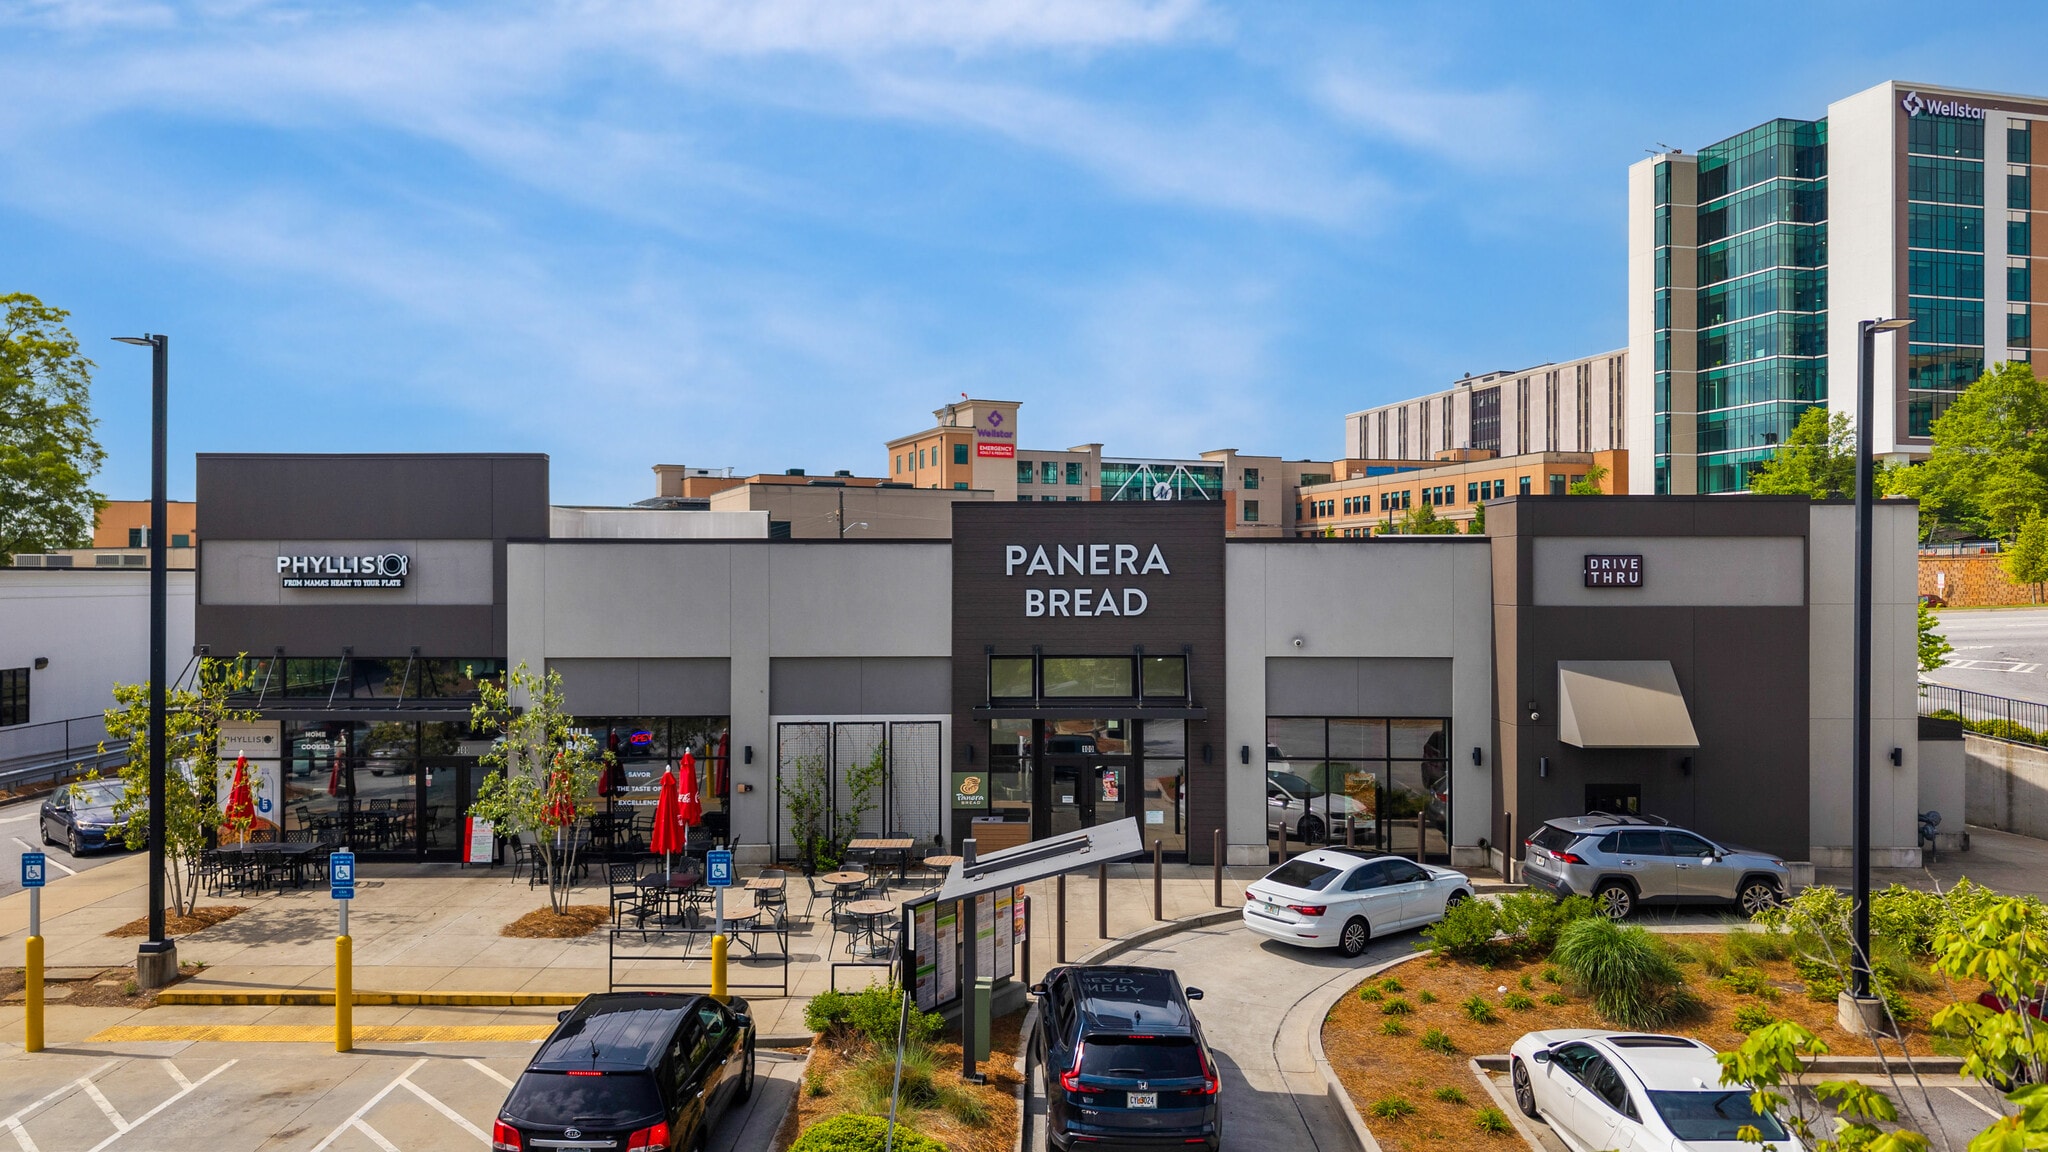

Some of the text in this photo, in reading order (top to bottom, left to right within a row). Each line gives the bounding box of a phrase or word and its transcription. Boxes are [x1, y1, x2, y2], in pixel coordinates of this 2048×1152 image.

[1926, 99, 1985, 119] Wellstar
[978, 429, 1012, 438] Wellstar
[277, 556, 376, 574] PHYLLIS
[1006, 544, 1170, 576] PANERA
[1590, 559, 1638, 569] DRIVE
[1591, 572, 1638, 583] THRU
[284, 579, 302, 587] FROM
[330, 579, 352, 587] HEART
[354, 579, 362, 587] TO
[363, 579, 380, 587] YOUR
[381, 579, 402, 587] PLATE
[1025, 588, 1148, 617] BREAD
[630, 733, 653, 743] OPEN
[955, 793, 984, 801] Panera
